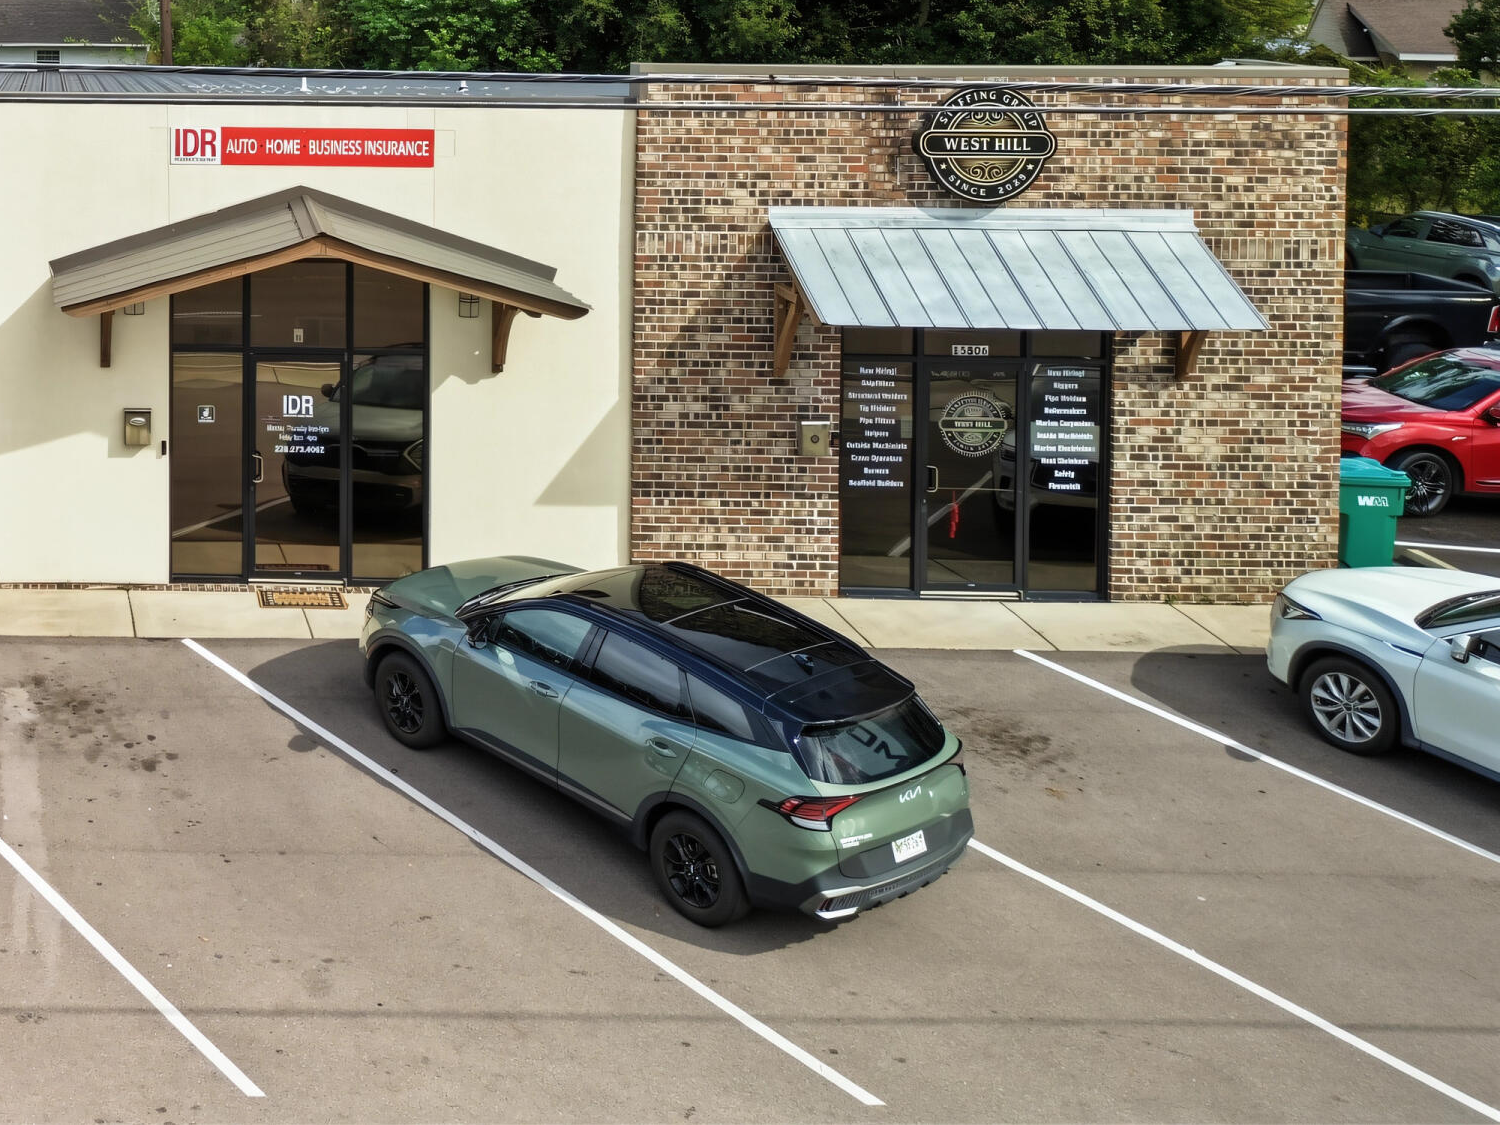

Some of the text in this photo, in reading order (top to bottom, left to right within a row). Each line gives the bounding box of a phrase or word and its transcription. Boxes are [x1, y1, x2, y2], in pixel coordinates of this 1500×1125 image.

[175, 129, 216, 157] IDR
[226, 138, 430, 157] AUTO HOME BUSINESS INSURANCE
[944, 137, 1031, 151] WEST HILL
[948, 174, 987, 196] SINCE
[283, 395, 314, 415] IDR
